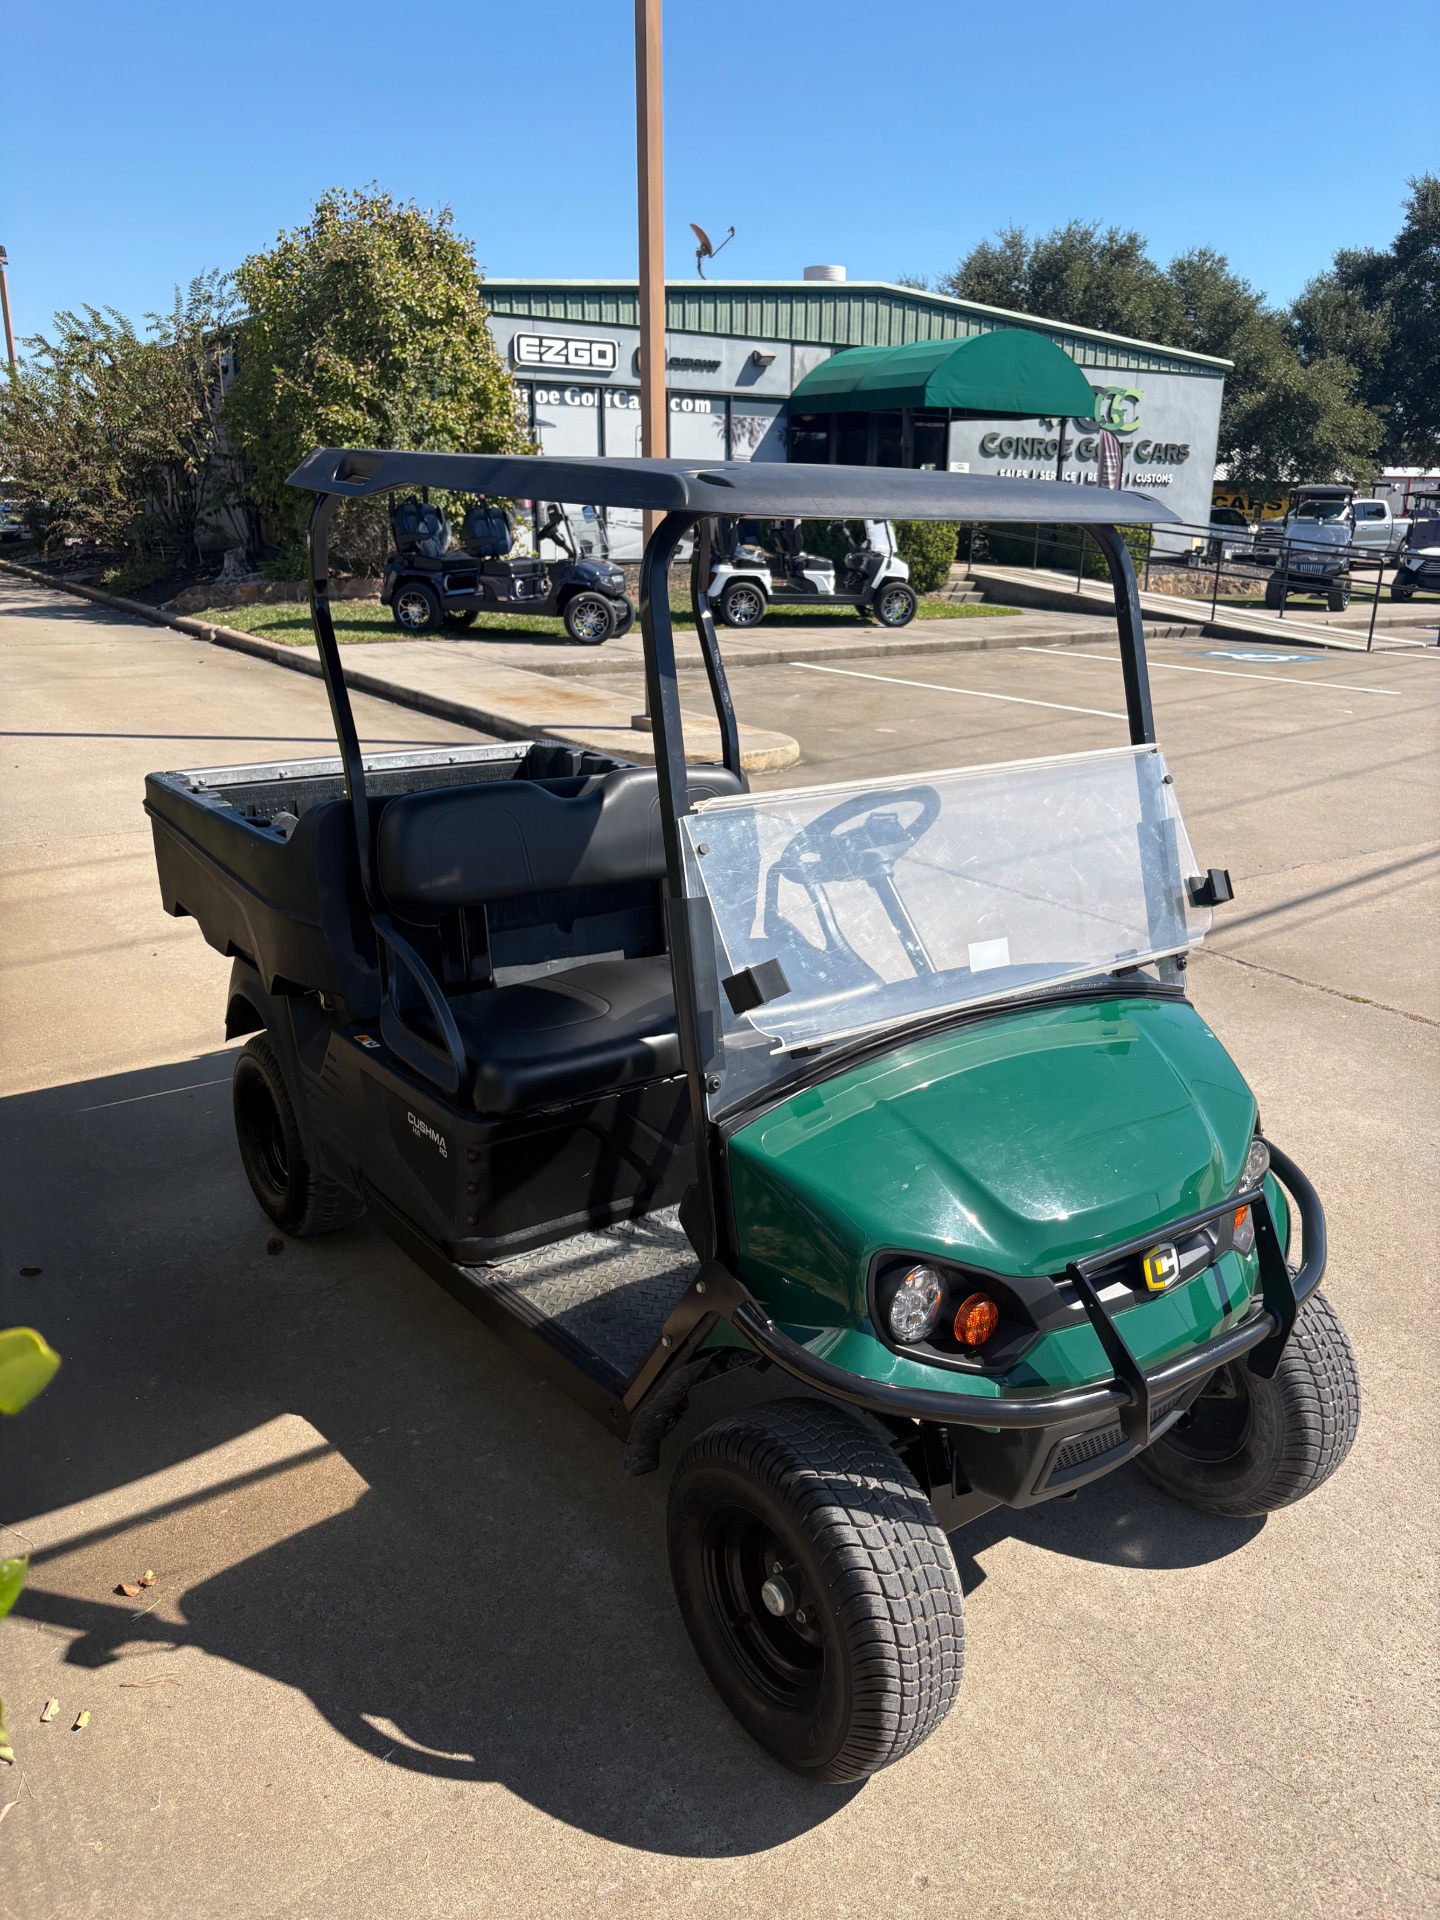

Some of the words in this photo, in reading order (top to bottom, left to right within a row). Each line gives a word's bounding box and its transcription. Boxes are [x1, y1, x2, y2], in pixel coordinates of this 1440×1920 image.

[519, 337, 614, 367] EZGO
[1137, 440, 1190, 461] CARS
[1040, 471, 1077, 483] SERICE
[1136, 474, 1174, 483] CUSTOMS
